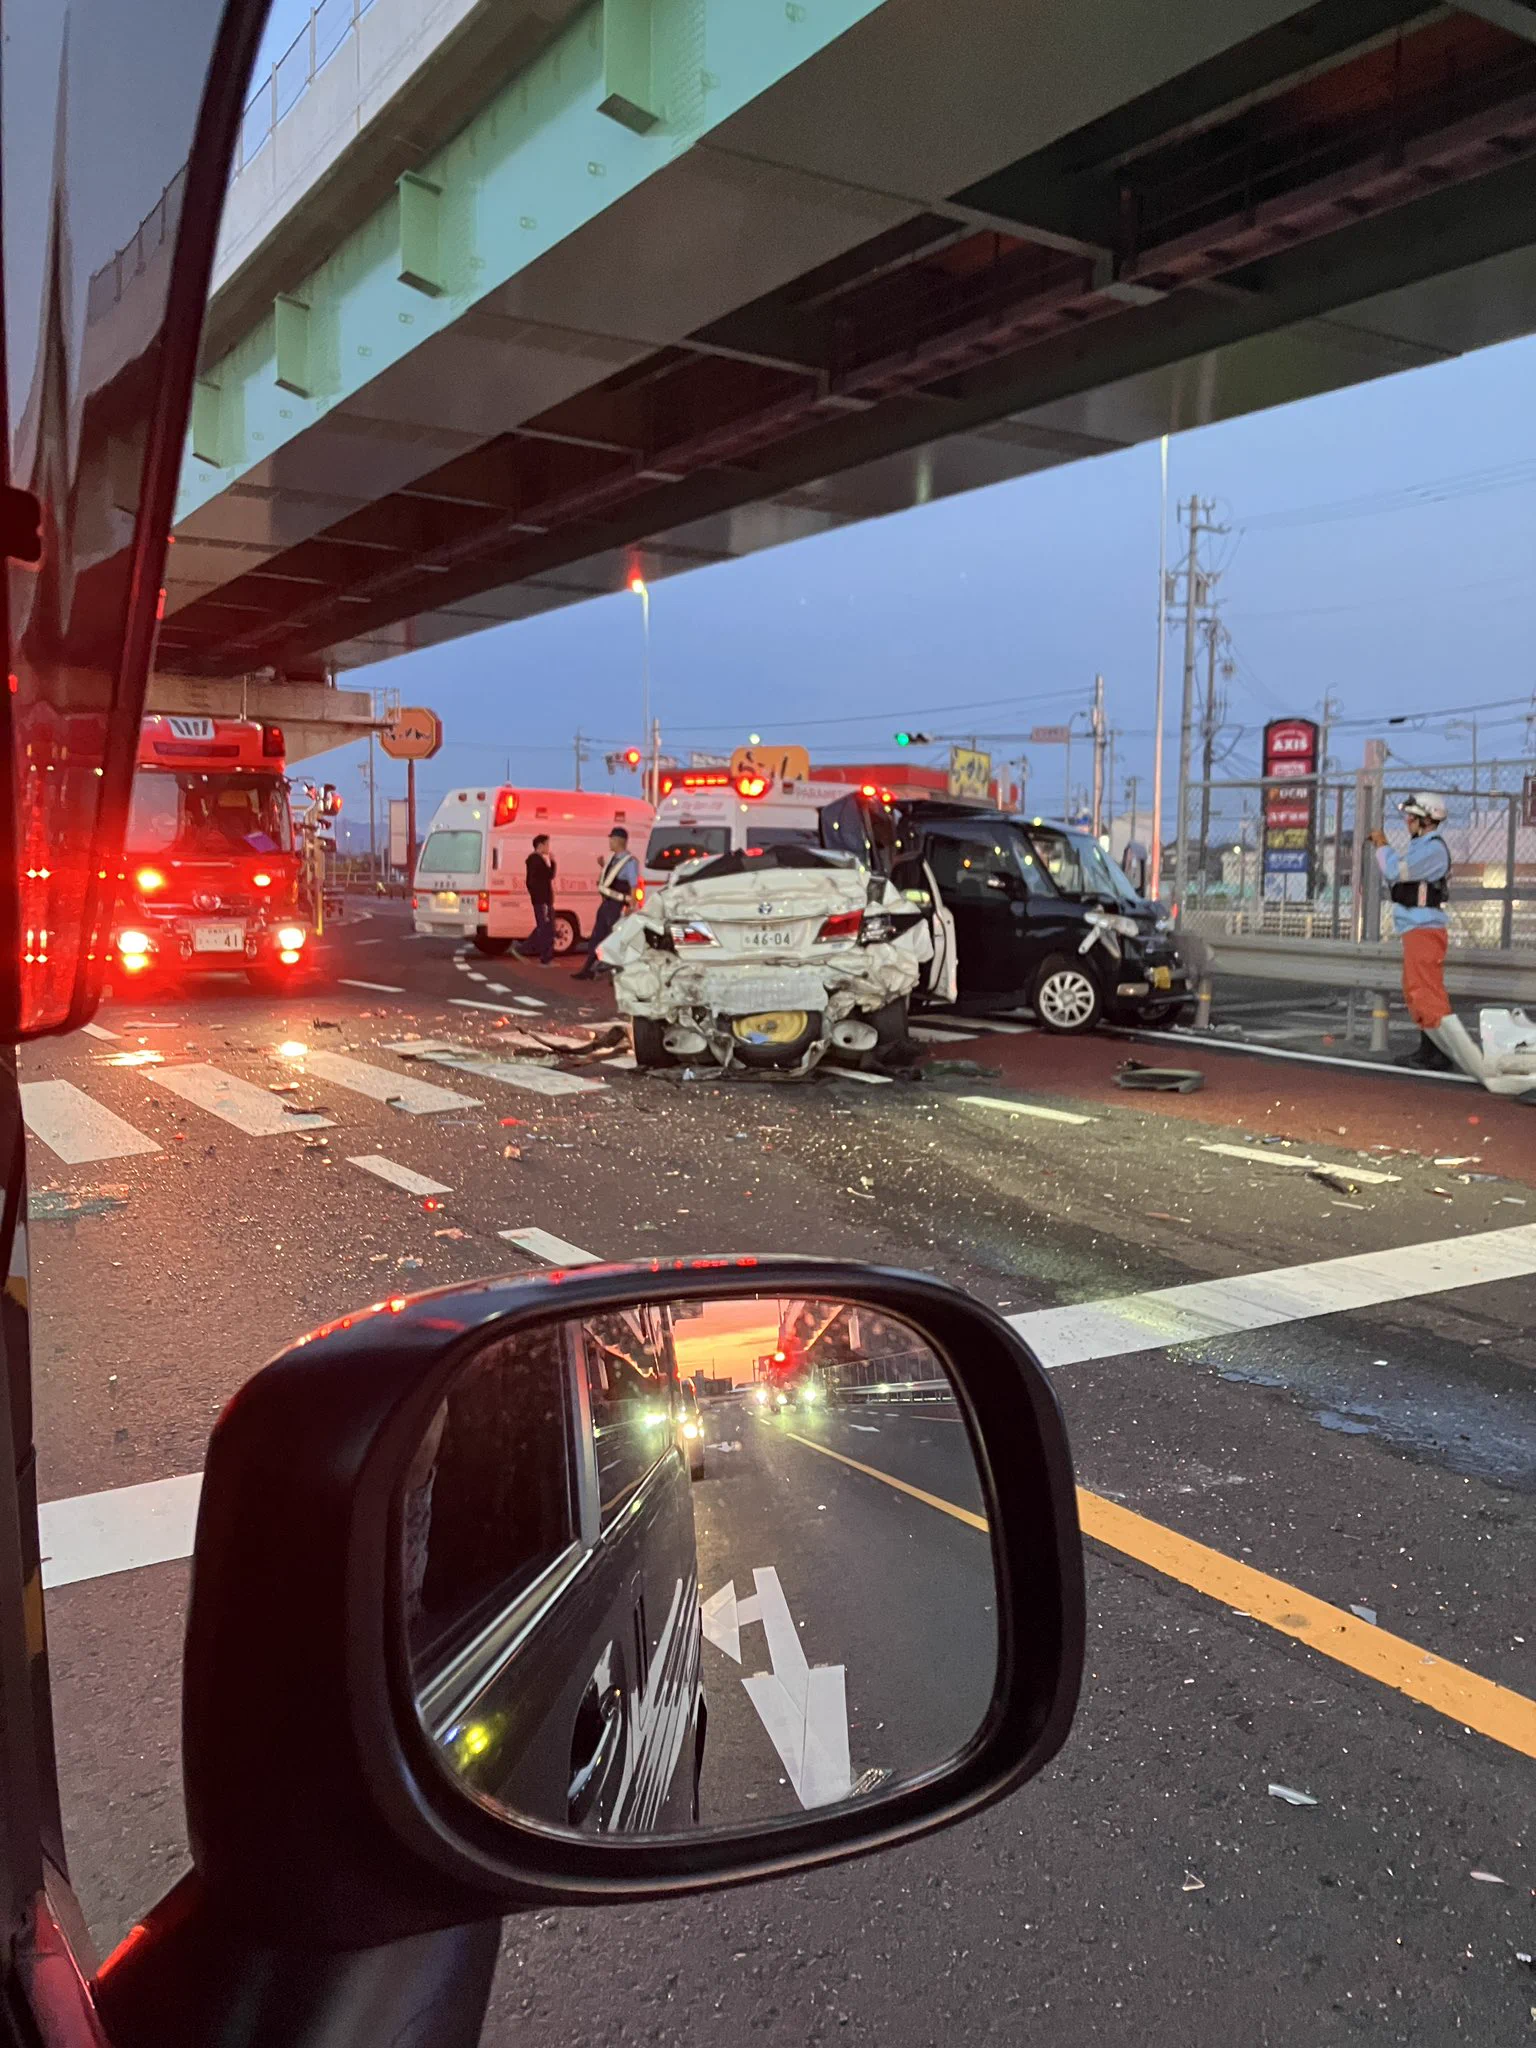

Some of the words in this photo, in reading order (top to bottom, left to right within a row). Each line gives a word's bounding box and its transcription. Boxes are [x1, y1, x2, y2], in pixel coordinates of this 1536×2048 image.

[1272, 738, 1308, 751] AXIS
[224, 934, 237, 947] 41
[753, 933, 790, 945] 46-04
